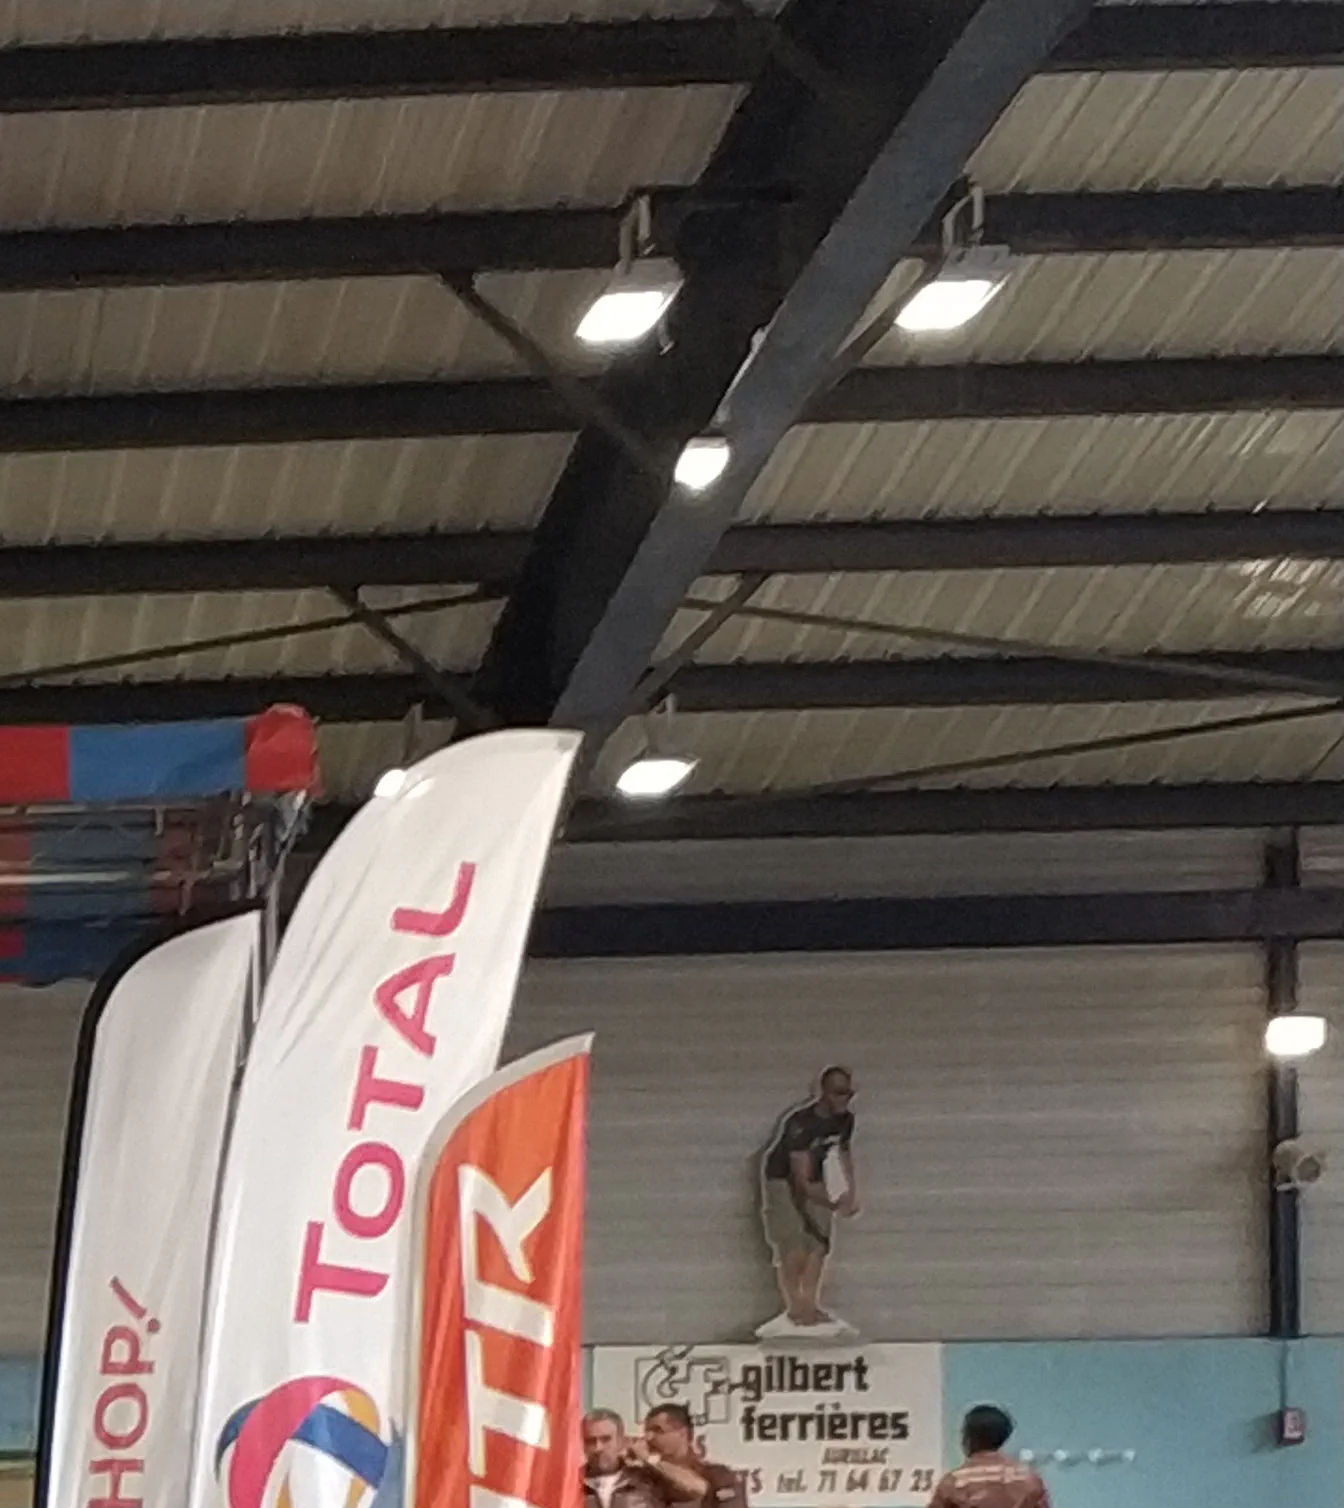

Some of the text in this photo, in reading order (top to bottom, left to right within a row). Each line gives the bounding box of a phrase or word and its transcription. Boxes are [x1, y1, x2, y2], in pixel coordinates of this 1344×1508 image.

[294, 861, 476, 1324] TOTAL
[740, 1355, 869, 1402] gilbert
[741, 1403, 910, 1440] ferrières
[817, 1469, 838, 1493] 71
